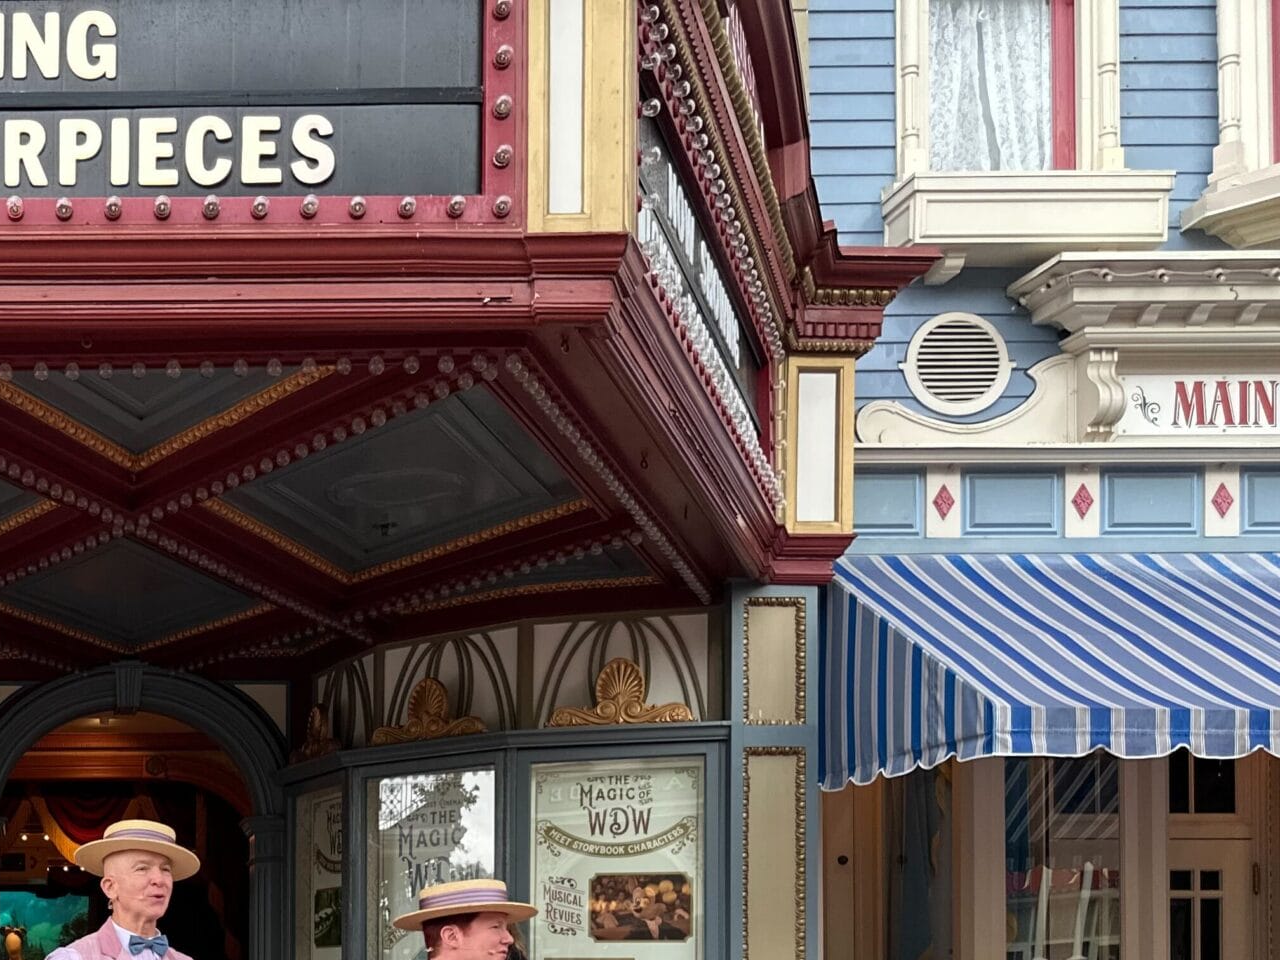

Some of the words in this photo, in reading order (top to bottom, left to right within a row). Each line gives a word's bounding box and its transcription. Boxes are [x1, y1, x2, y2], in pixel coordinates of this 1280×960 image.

[1171, 380, 1280, 429] MAIN
[608, 775, 630, 785] THE
[576, 783, 635, 809] MAGIC
[638, 789, 651, 799] OF
[429, 810, 456, 825] THE
[583, 805, 652, 838] WDW
[549, 829, 570, 847] MEET
[572, 841, 625, 855] STORYBOOK
[628, 827, 684, 854] CHARACTERS
[542, 884, 584, 908] MUSICAL
[545, 902, 582, 926] REVUES
